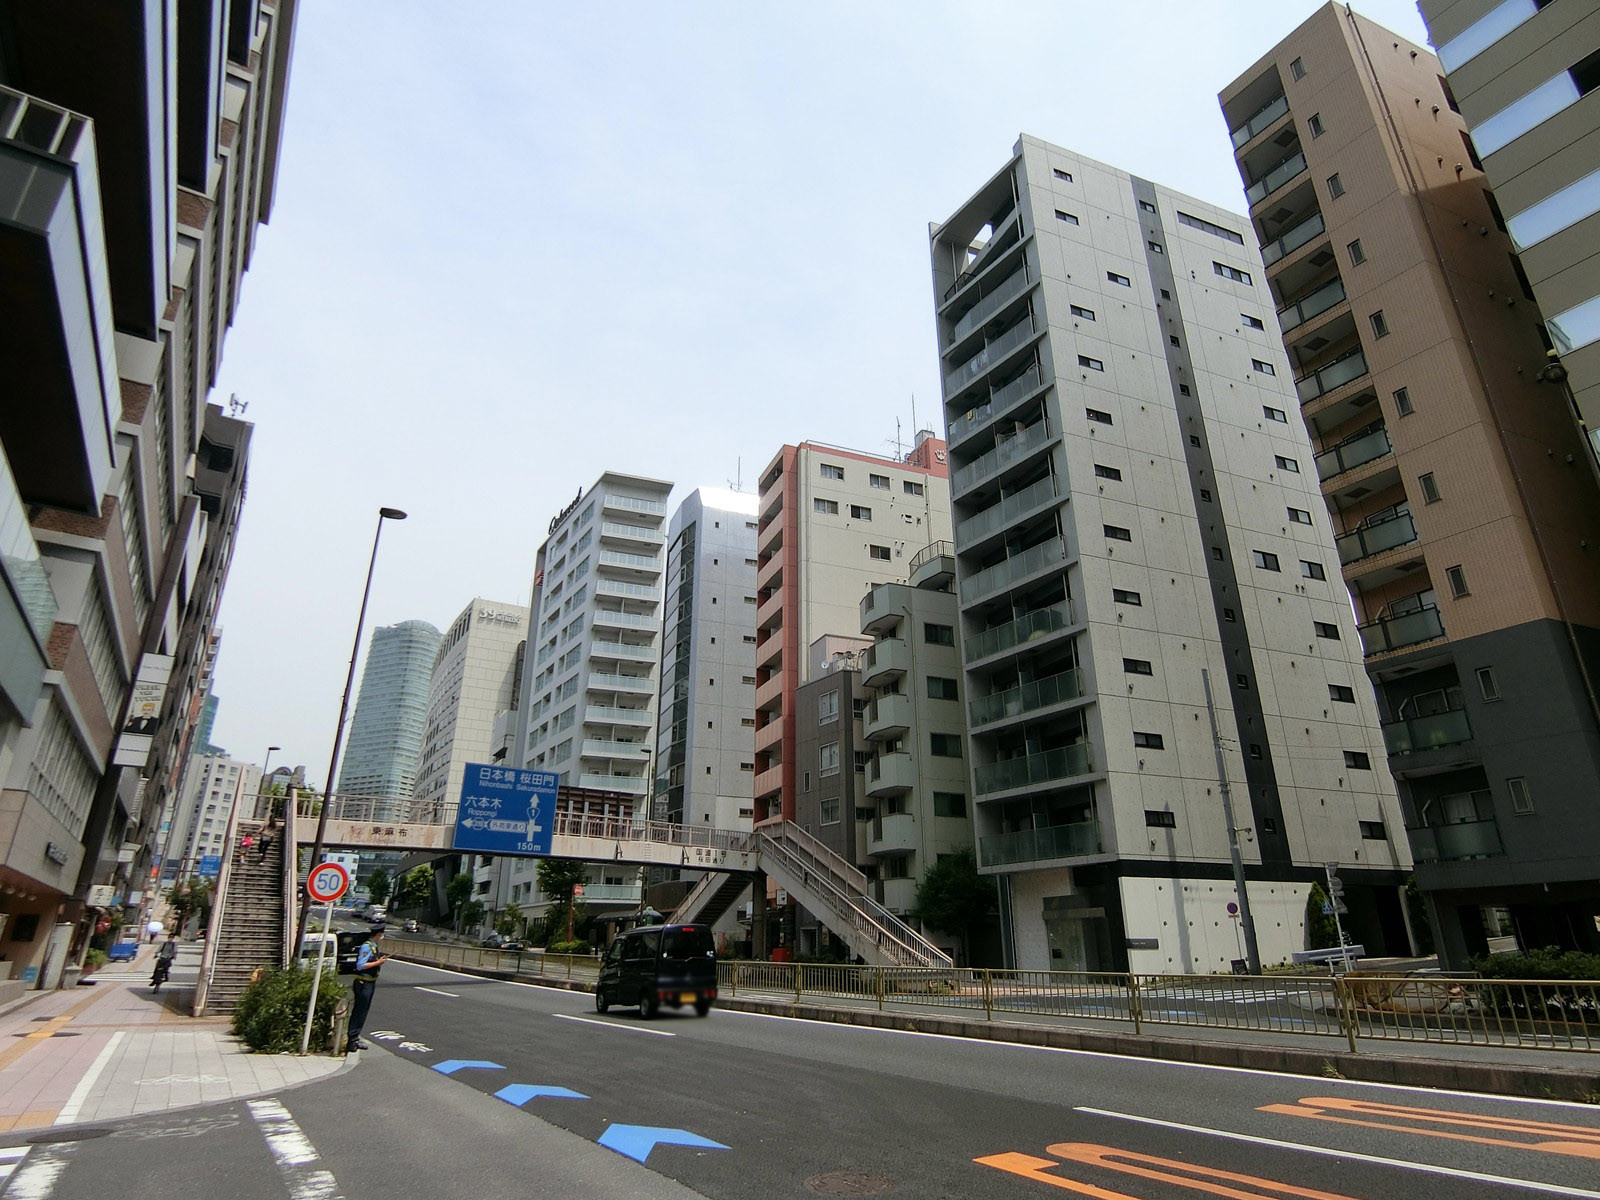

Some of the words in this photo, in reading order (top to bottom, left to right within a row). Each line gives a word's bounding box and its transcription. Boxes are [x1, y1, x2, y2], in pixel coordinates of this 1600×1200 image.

[480, 768, 516, 782] 日本橋
[520, 772, 555, 787] 桜田門
[479, 780, 513, 789] Nihonbashi
[465, 795, 502, 809] 六本木
[468, 808, 497, 818] Roppongi
[517, 842, 541, 851] 150m
[317, 873, 340, 891] 50
